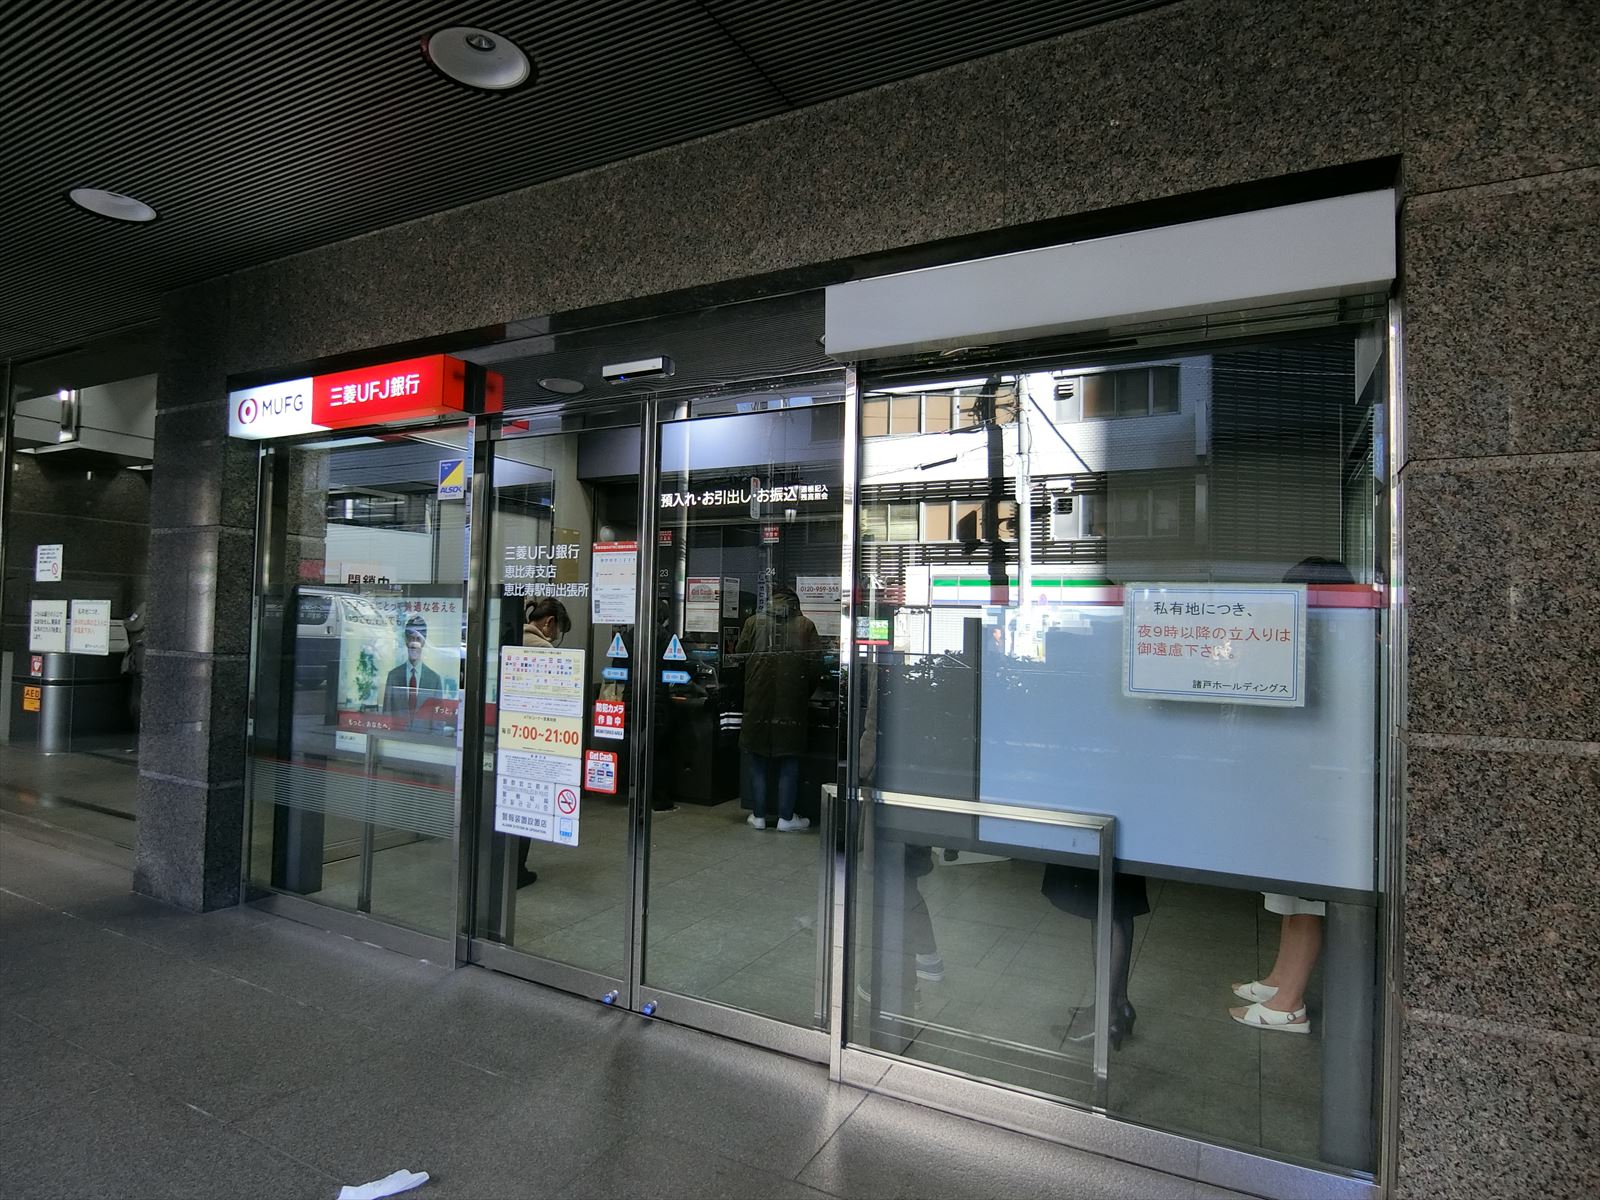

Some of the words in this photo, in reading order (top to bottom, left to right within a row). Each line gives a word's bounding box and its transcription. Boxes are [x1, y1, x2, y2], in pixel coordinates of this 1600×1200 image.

[330, 374, 420, 407] 三菱UFJ銀行
[262, 394, 304, 417] MUFG
[440, 485, 462, 494] ALSOK
[504, 544, 580, 561] 三菱UFJ銀行
[504, 565, 557, 579] 恵比寿支店
[659, 569, 669, 578] 23
[765, 568, 776, 577] 24
[504, 583, 589, 598] 恵比寿駅前出張所
[1153, 602, 1252, 617] 私有地につき、
[1137, 624, 1291, 642] 夜9時以降の立入りは
[25, 688, 40, 698] AED
[1192, 680, 1289, 693] 諸戸ホールディングス
[596, 702, 625, 714] 防犯カメラ
